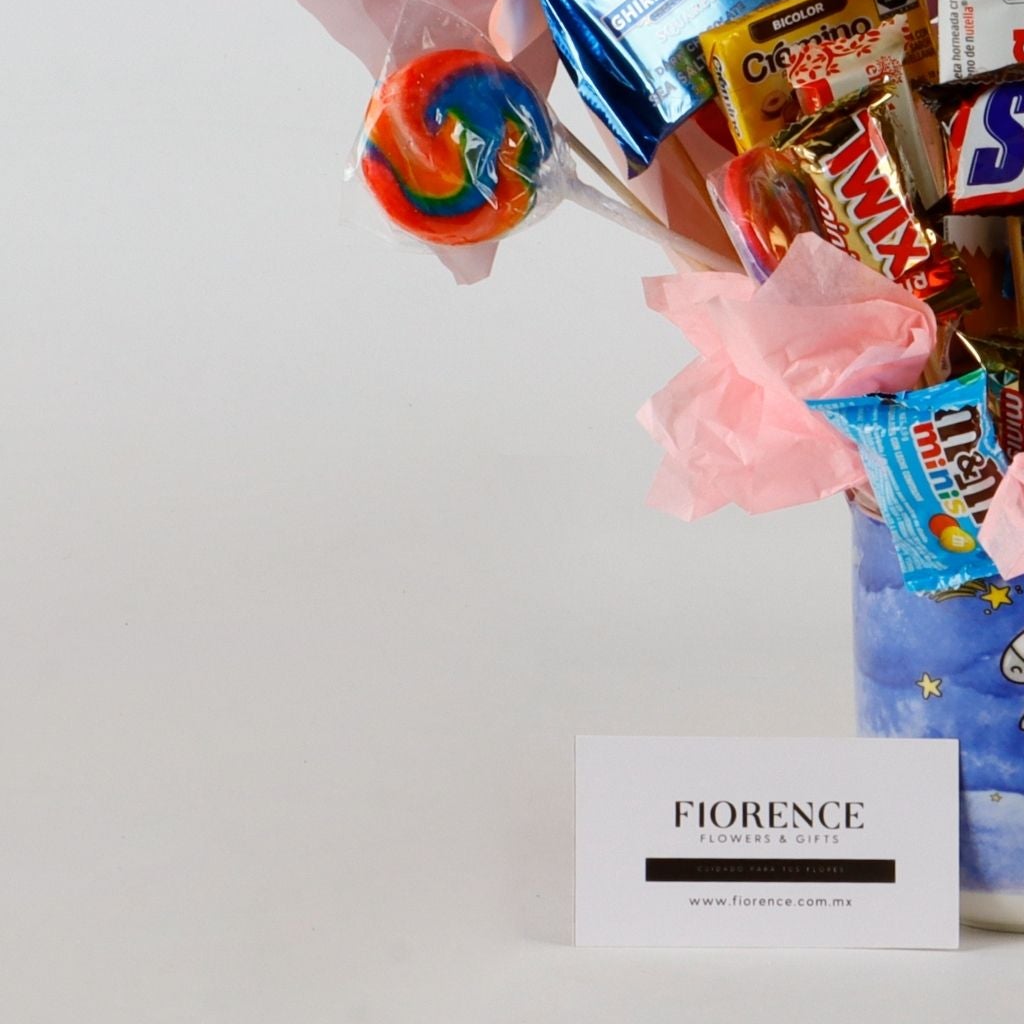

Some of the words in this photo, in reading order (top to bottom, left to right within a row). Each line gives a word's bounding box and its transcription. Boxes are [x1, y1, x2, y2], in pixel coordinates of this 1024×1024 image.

[772, 2, 824, 31] BICOLOR
[967, 42, 976, 57] de
[826, 110, 928, 282] TWIX
[913, 422, 967, 517] minis
[674, 801, 865, 829] FIORENCE
[700, 834, 771, 844] FLOWERS
[779, 834, 787, 844] &
[796, 834, 839, 844] GIFTS
[689, 895, 853, 907] www.fiorence.com.mx
